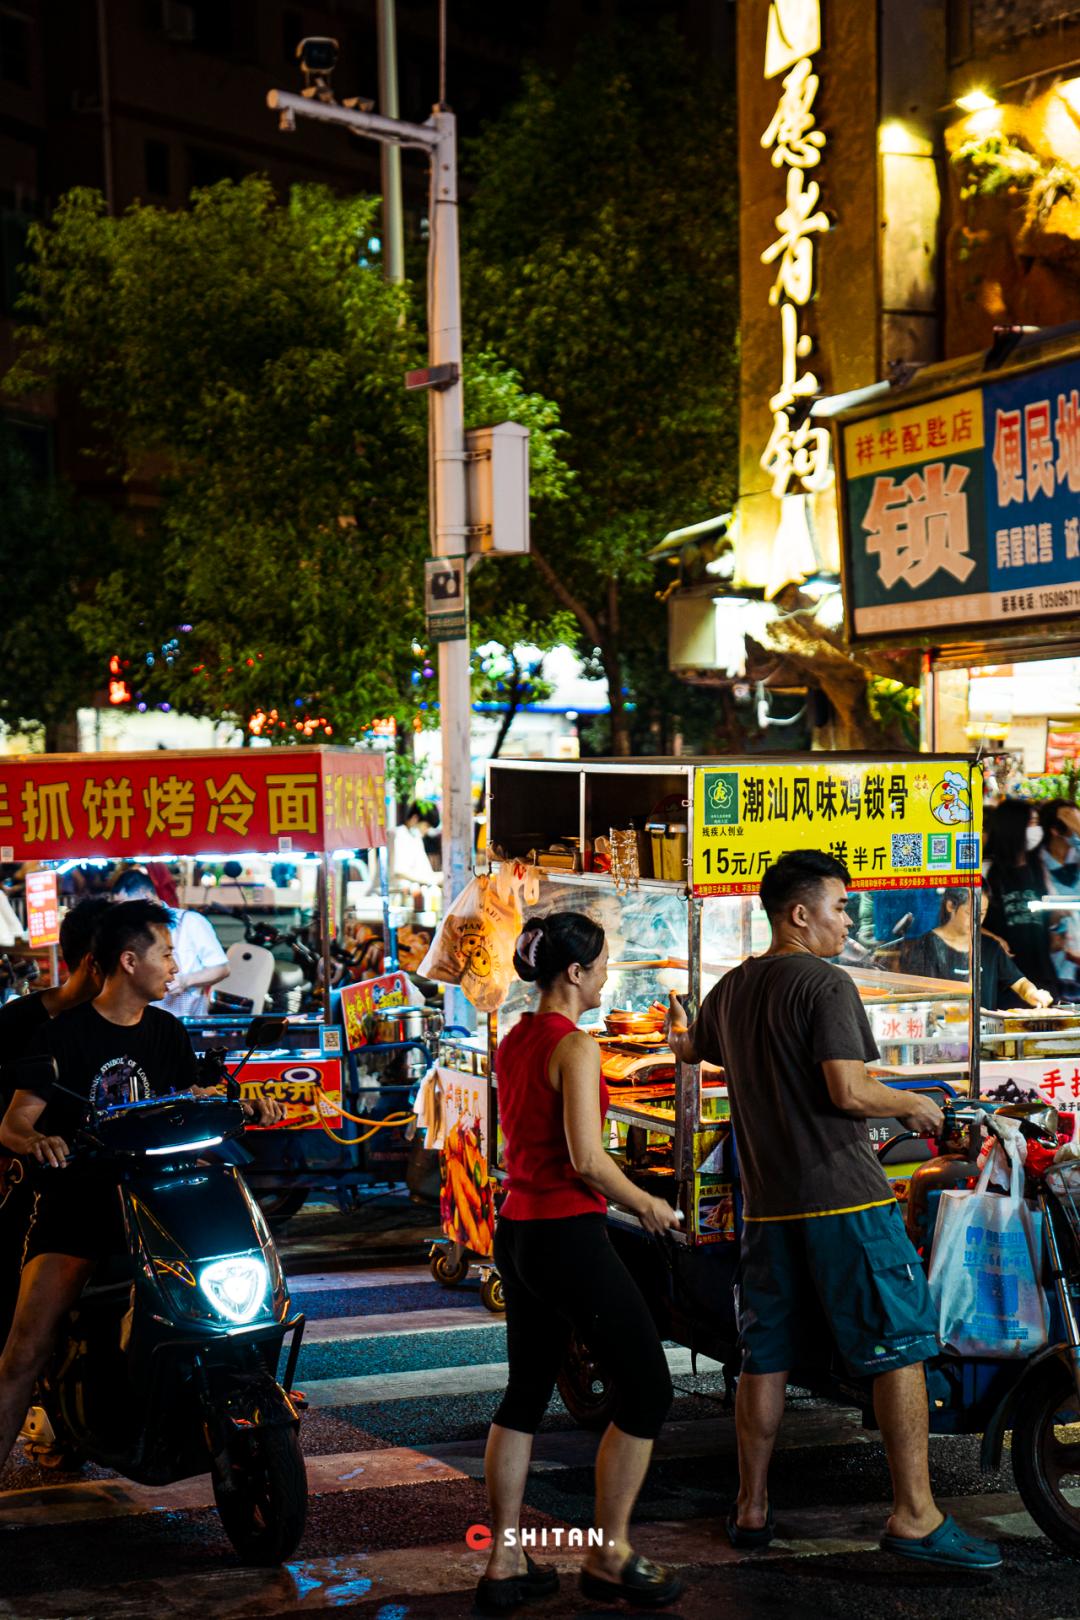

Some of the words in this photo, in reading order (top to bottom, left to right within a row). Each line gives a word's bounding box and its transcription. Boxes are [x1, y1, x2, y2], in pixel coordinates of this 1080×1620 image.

[856, 409, 973, 466] 祥华配匙店
[861, 462, 977, 590] 锁
[742, 775, 909, 822] 潮汕风味鸡锁骨
[702, 827, 744, 838] 残疾人创业
[882, 1017, 923, 1038] 冰粉
